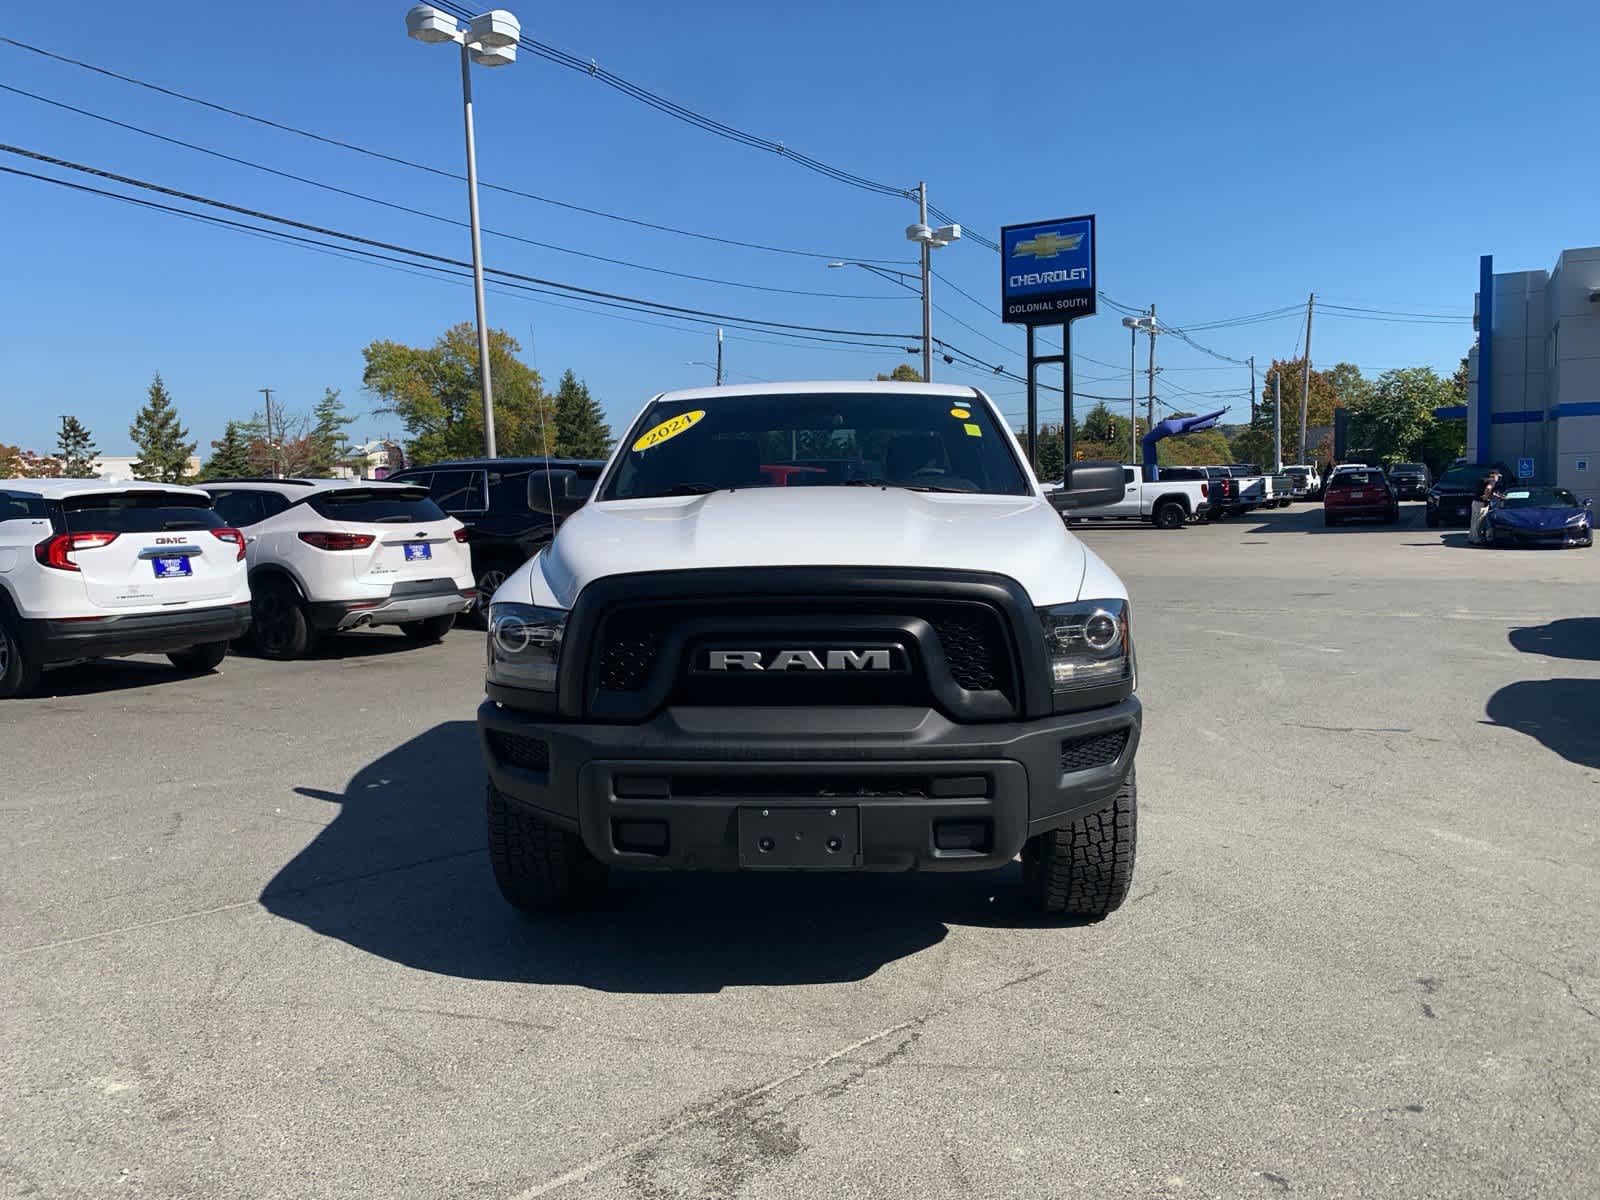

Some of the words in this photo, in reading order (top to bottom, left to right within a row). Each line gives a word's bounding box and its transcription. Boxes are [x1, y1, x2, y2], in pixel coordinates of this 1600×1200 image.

[1009, 267, 1087, 288] CHEVROLET
[1009, 301, 1053, 314] COLONIAL
[1056, 298, 1088, 310] SOUTH
[646, 415, 692, 445] 2024
[155, 537, 188, 545] GMC
[709, 650, 890, 671] RAM
